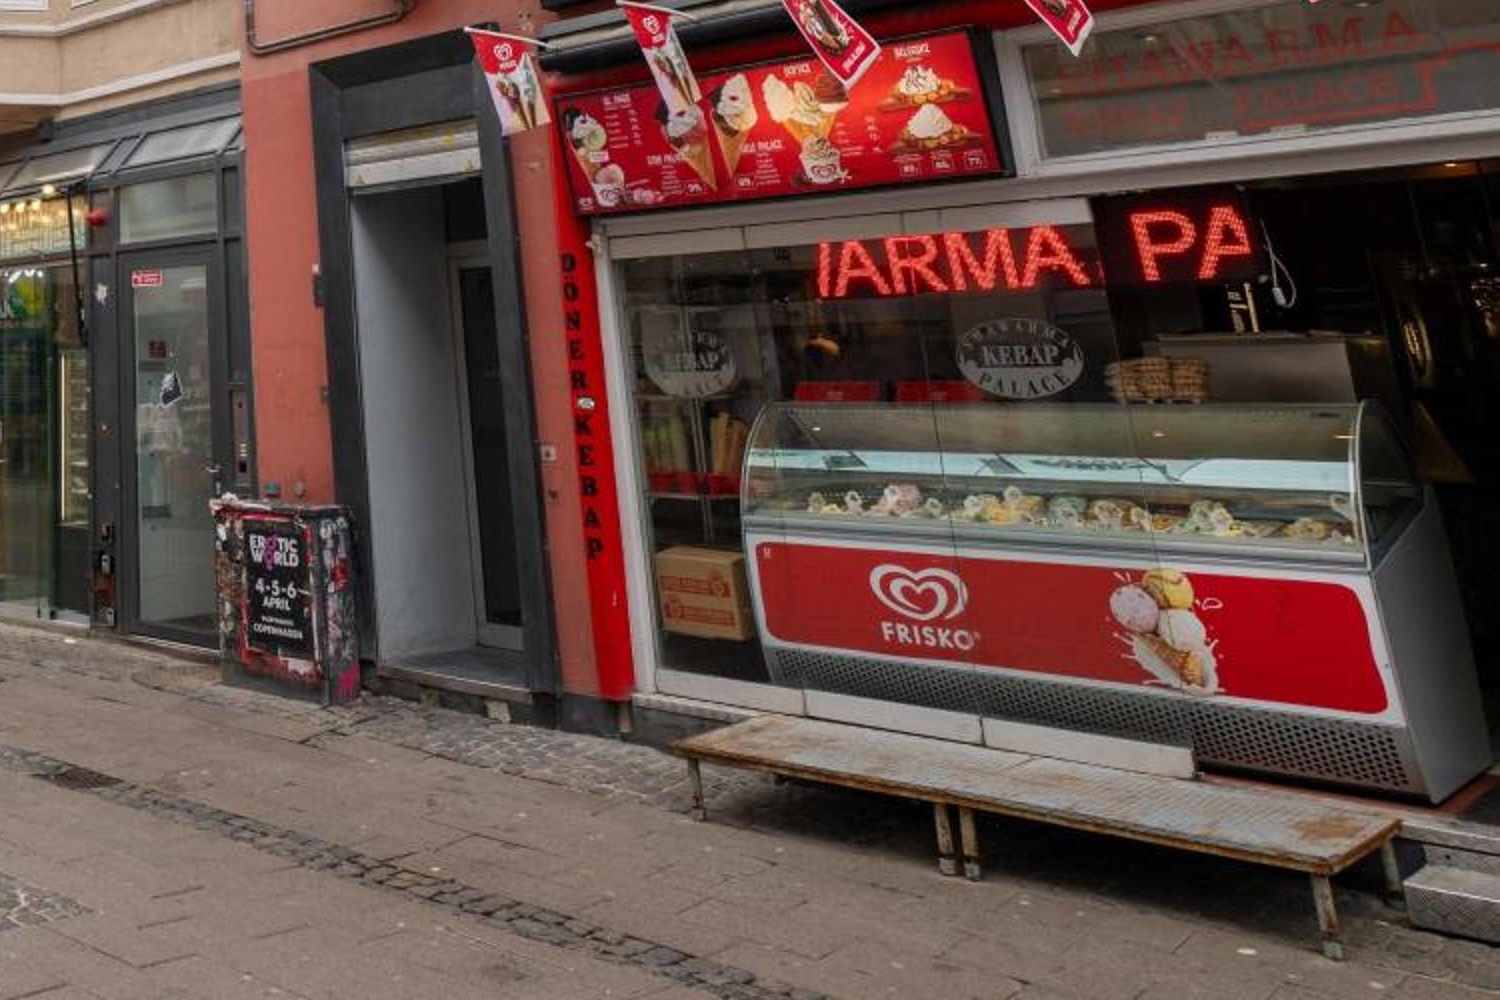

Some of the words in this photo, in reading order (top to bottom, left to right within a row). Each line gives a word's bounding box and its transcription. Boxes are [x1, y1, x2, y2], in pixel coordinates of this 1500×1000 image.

[981, 344, 1060, 366] KEBAP
[249, 534, 298, 553] EROTIC
[251, 548, 300, 568] WORLD
[262, 597, 291, 612] APRIL
[881, 621, 975, 651] FRISKO
